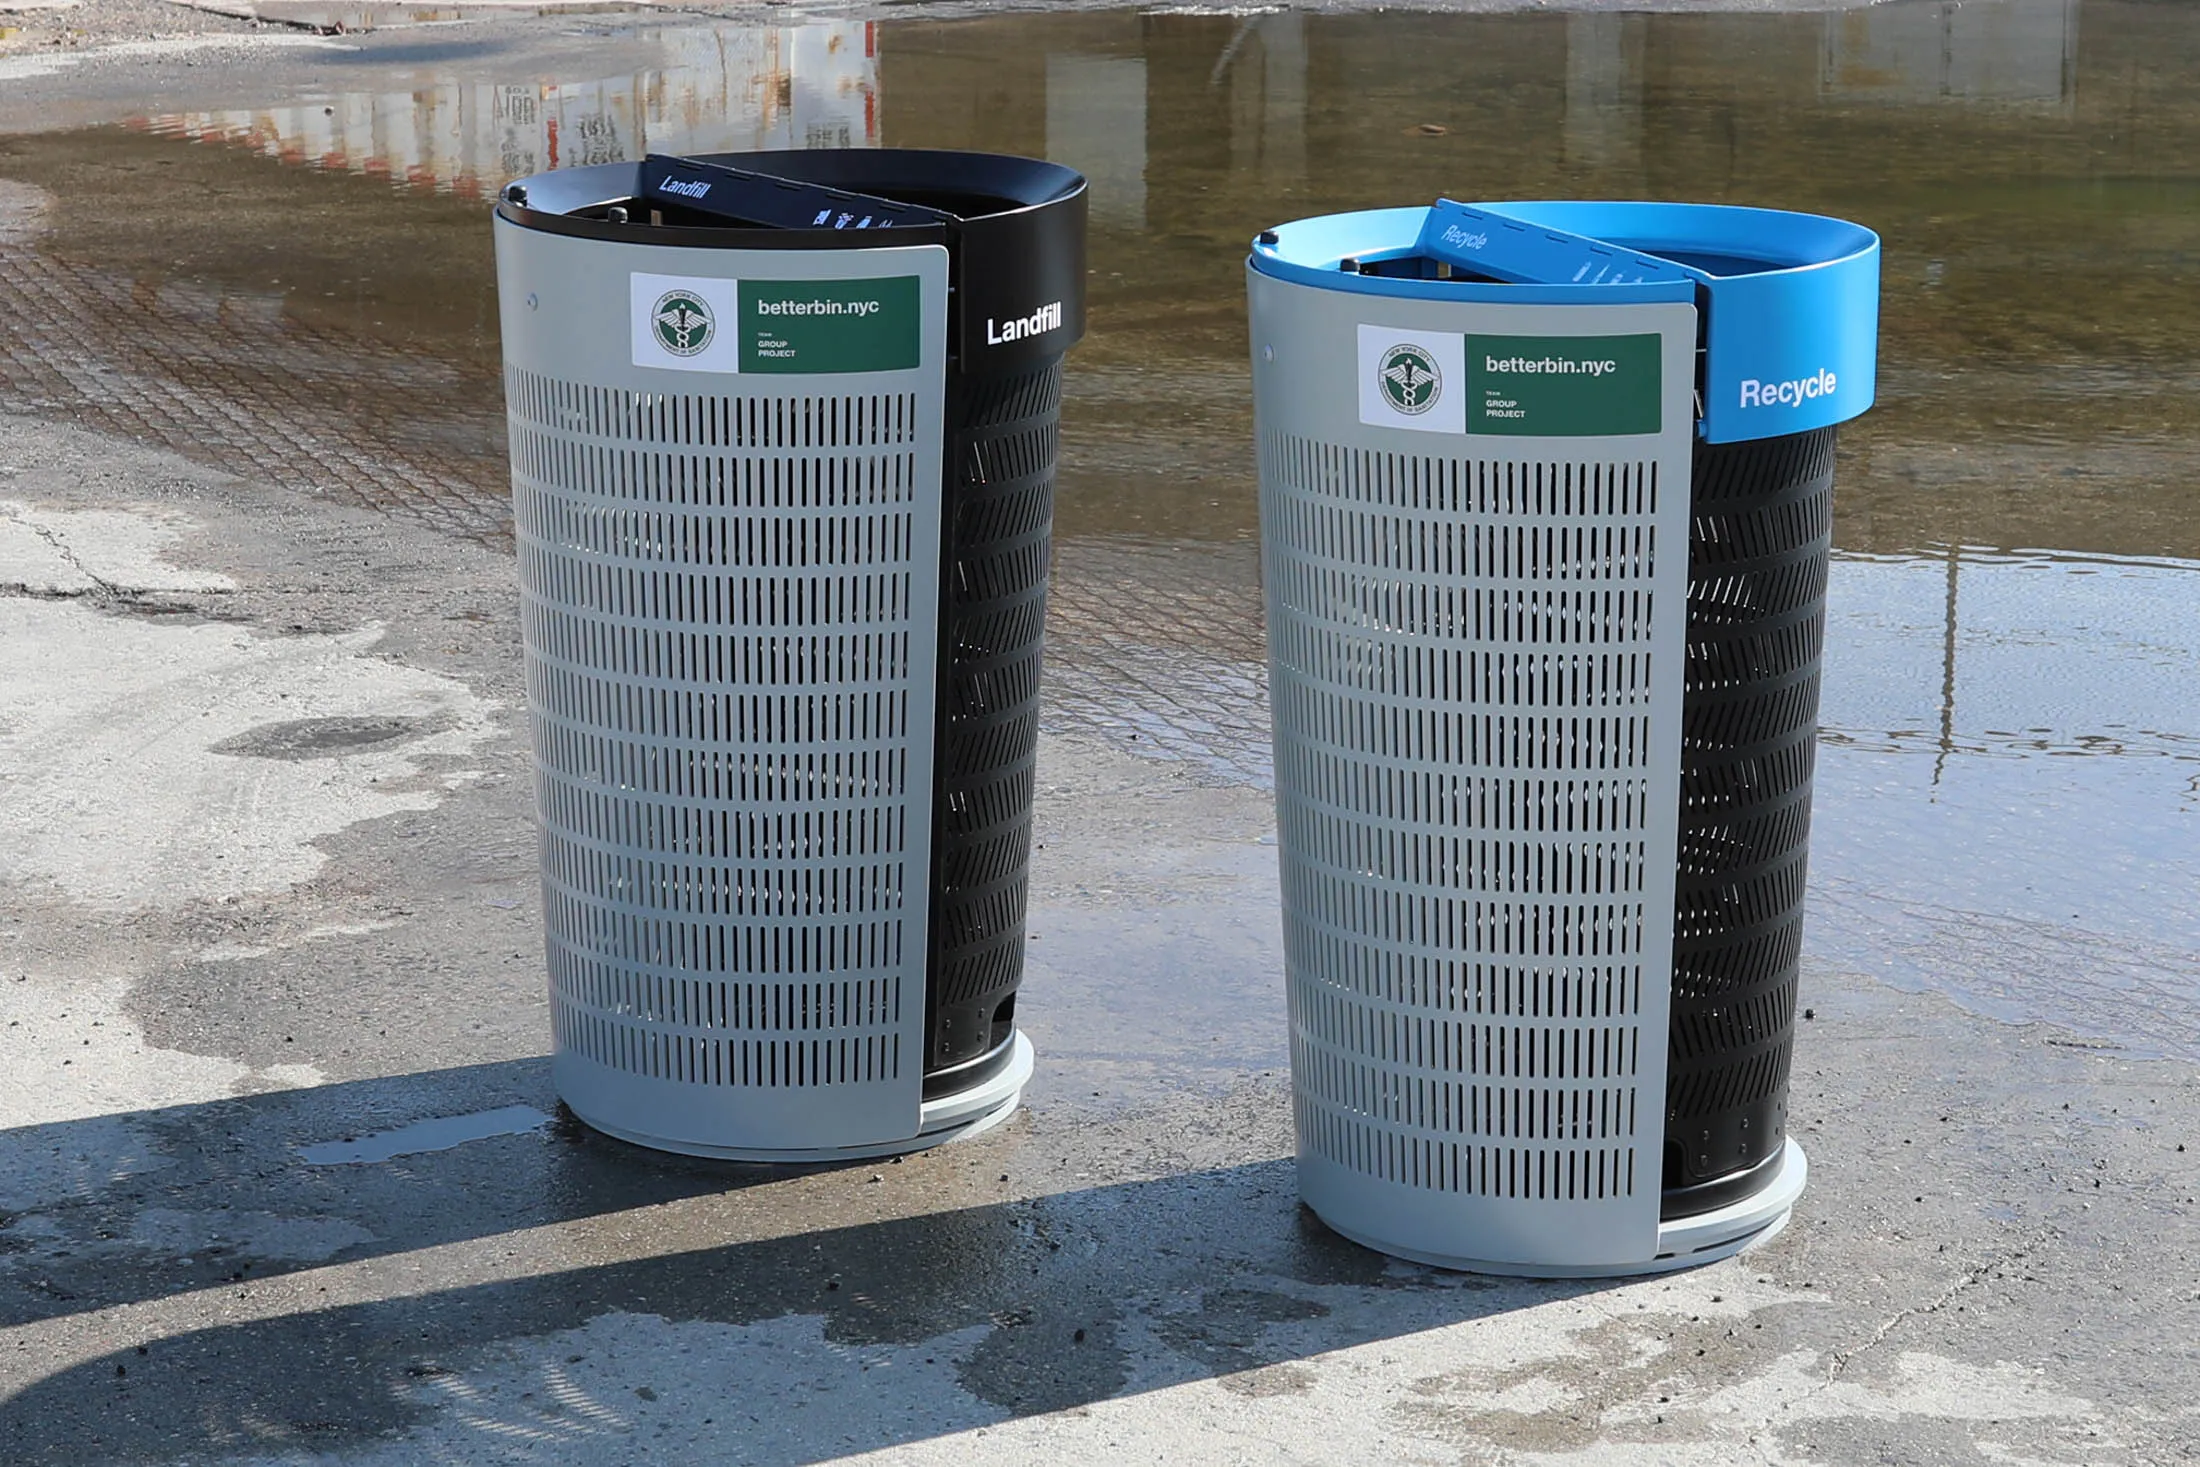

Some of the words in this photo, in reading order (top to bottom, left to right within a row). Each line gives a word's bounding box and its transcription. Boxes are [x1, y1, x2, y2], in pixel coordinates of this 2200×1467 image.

[659, 175, 712, 199] Landfill
[1441, 224, 1488, 250] Recycle
[758, 299, 880, 317] betterbin.nyc
[987, 301, 1062, 345] Landfill
[758, 340, 788, 348] GROUP
[1486, 355, 1616, 377] betterbin.nyc
[1740, 367, 1837, 409] Recycle
[1486, 400, 1517, 408] GROUP
[1486, 410, 1526, 418] PROJECT
